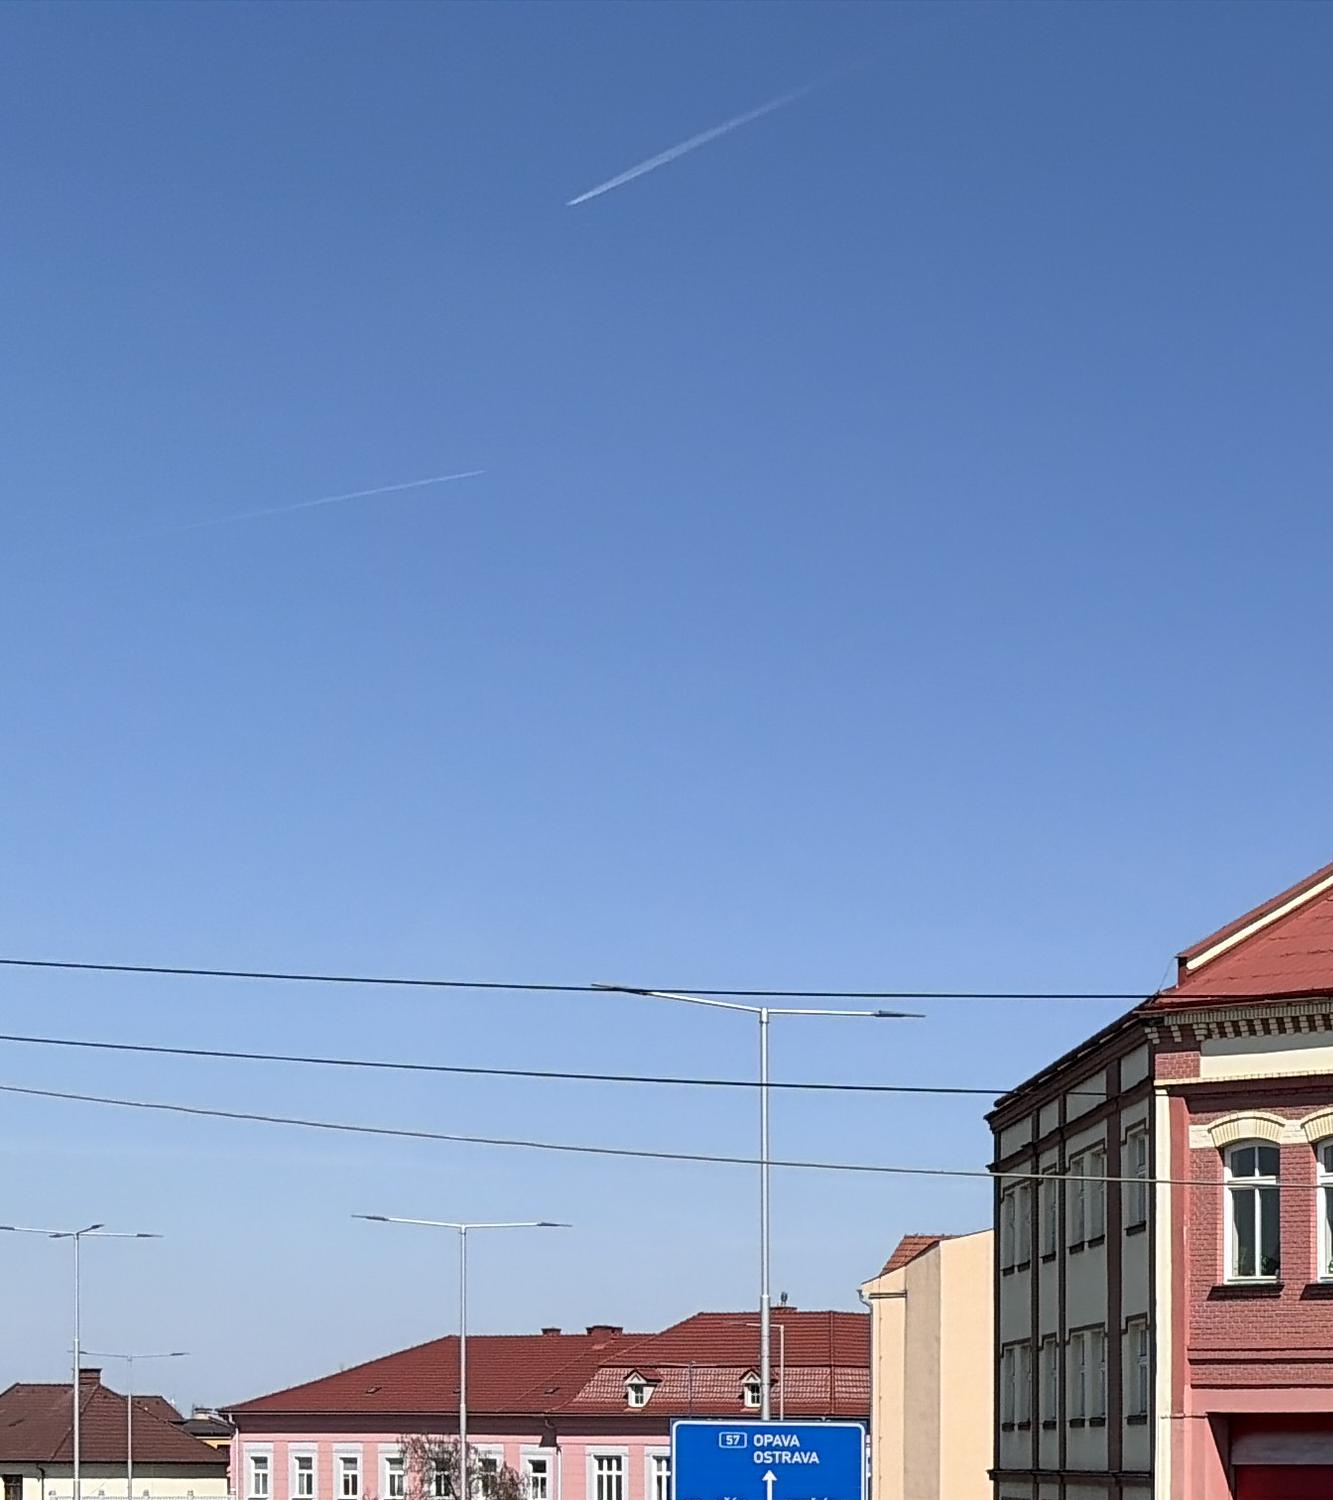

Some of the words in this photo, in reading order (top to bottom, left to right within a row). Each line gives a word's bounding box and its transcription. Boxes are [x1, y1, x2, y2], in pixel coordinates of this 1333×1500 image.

[725, 1434, 740, 1446] 57
[753, 1434, 800, 1447] OPAVA
[753, 1450, 820, 1464] OSTRAVA
